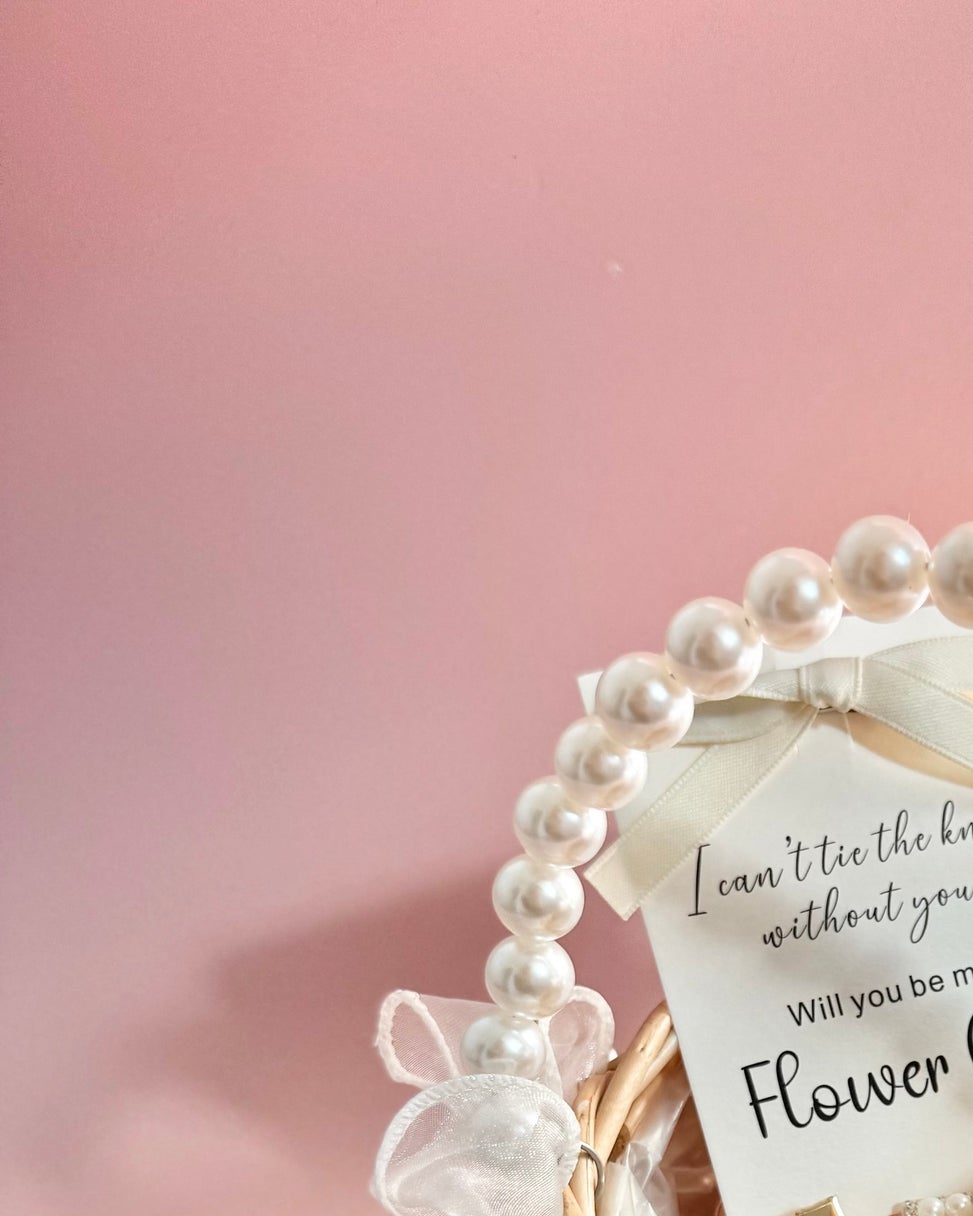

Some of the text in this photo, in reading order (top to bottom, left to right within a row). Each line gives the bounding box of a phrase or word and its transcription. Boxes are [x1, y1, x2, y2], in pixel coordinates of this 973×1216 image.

[688, 844, 711, 917] I
[821, 834, 869, 876] tie
[870, 809, 932, 864] the
[763, 881, 903, 949] without
[787, 993, 844, 1027] Will
[850, 983, 902, 1019] you
[909, 972, 945, 999] be
[741, 1050, 950, 1139] Flower
